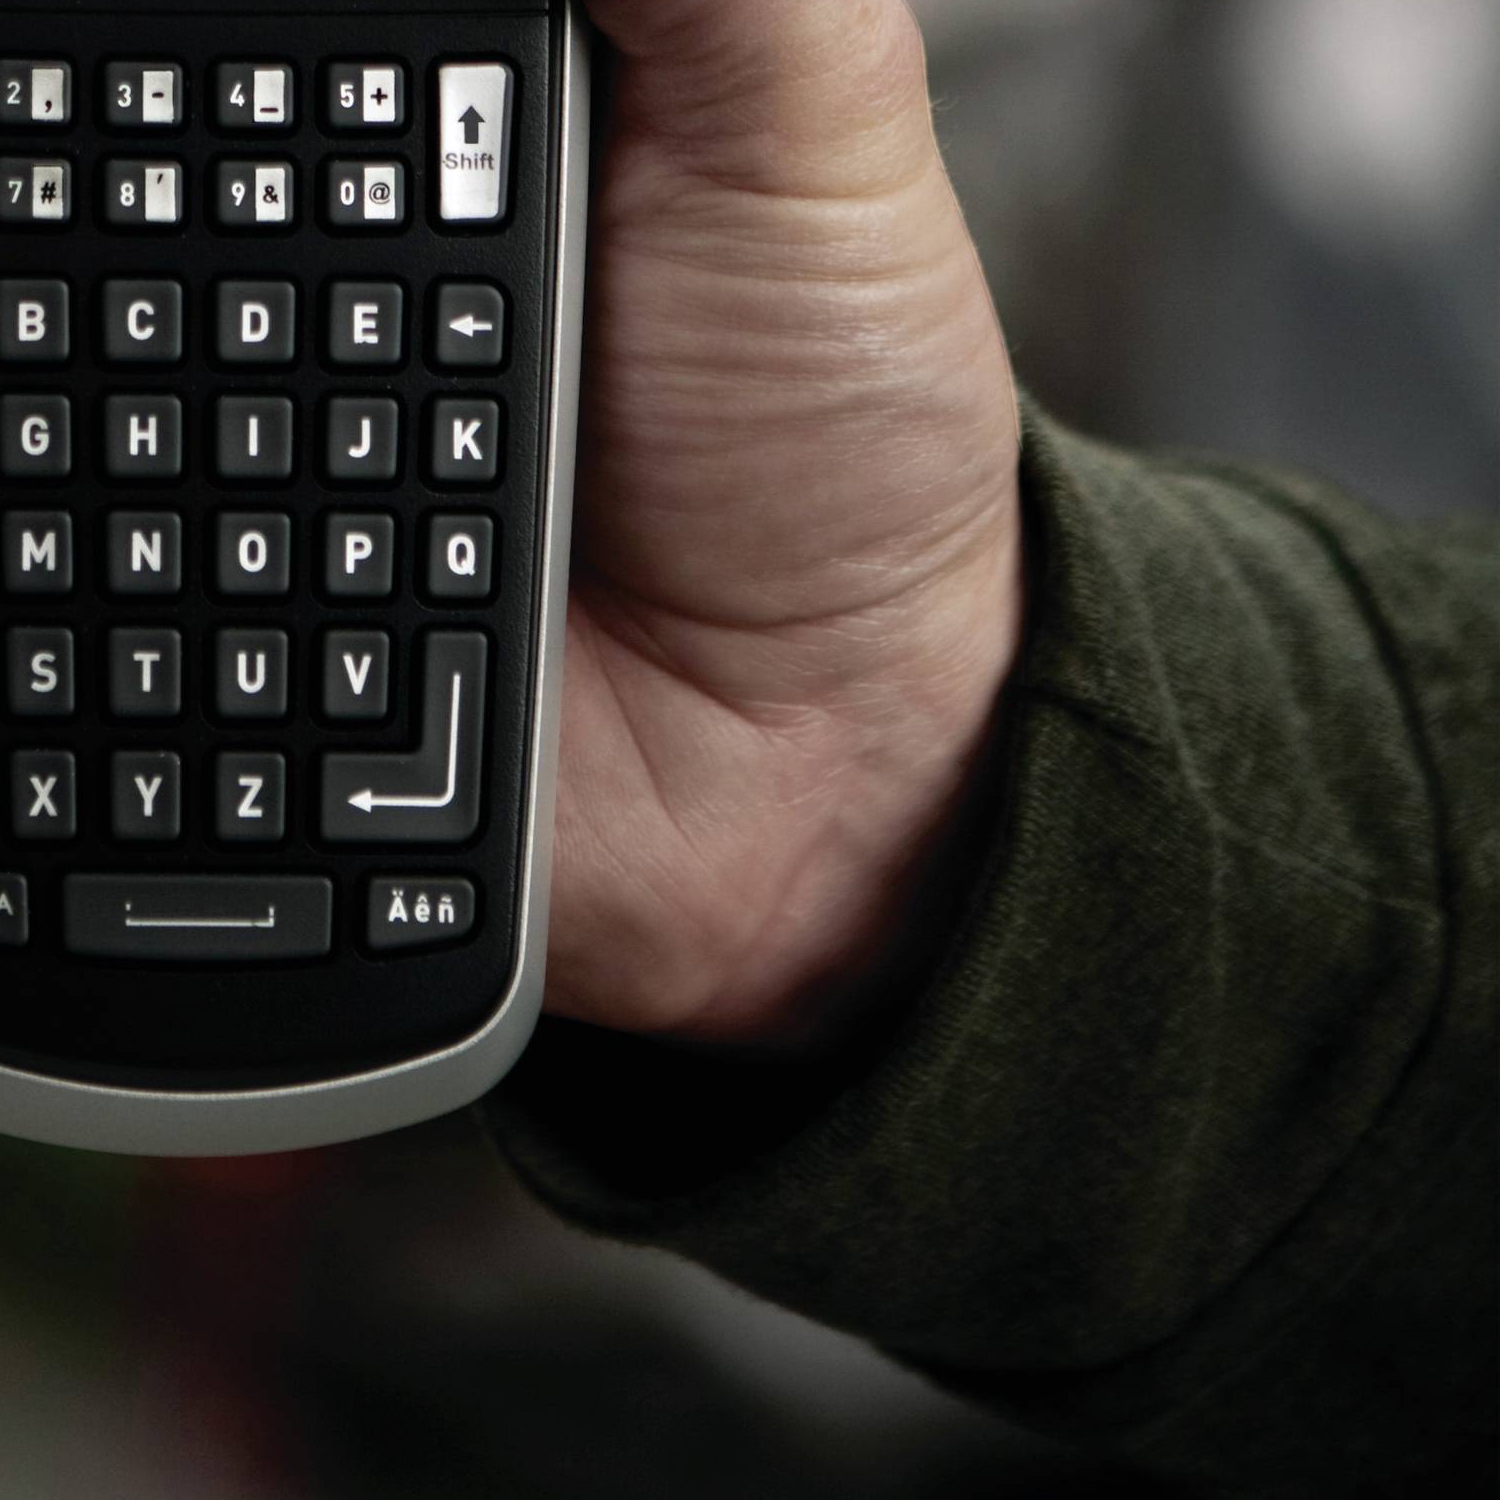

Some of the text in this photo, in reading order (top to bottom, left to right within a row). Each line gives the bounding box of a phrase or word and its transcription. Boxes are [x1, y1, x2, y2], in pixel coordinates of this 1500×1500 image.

[7, 81, 21, 104] 2
[117, 83, 132, 108] 3
[229, 83, 245, 107] 4
[340, 83, 355, 108] 5
[444, 152, 495, 171] Shift
[8, 180, 23, 204] 7
[120, 182, 135, 207] 8
[231, 182, 279, 207] 9 &
[340, 180, 391, 206] 0 @
[18, 302, 45, 341] B
[127, 301, 155, 341] C
[241, 303, 269, 343] D
[353, 304, 379, 344] E
[21, 416, 49, 456] G
[129, 416, 157, 456] H
[248, 416, 258, 457] I
[348, 418, 371, 458] J
[453, 419, 483, 460] K
[22, 531, 56, 571] M
[131, 531, 161, 572] N
[238, 532, 267, 573] O
[345, 533, 373, 574] P
[447, 534, 476, 576] Q
[30, 652, 57, 693] S
[133, 652, 160, 693] T
[237, 652, 265, 694] U
[343, 653, 372, 695] V
[29, 776, 57, 817] X
[134, 776, 162, 817] Y
[237, 776, 263, 818] Z
[388, 889, 455, 924] Äêñ
